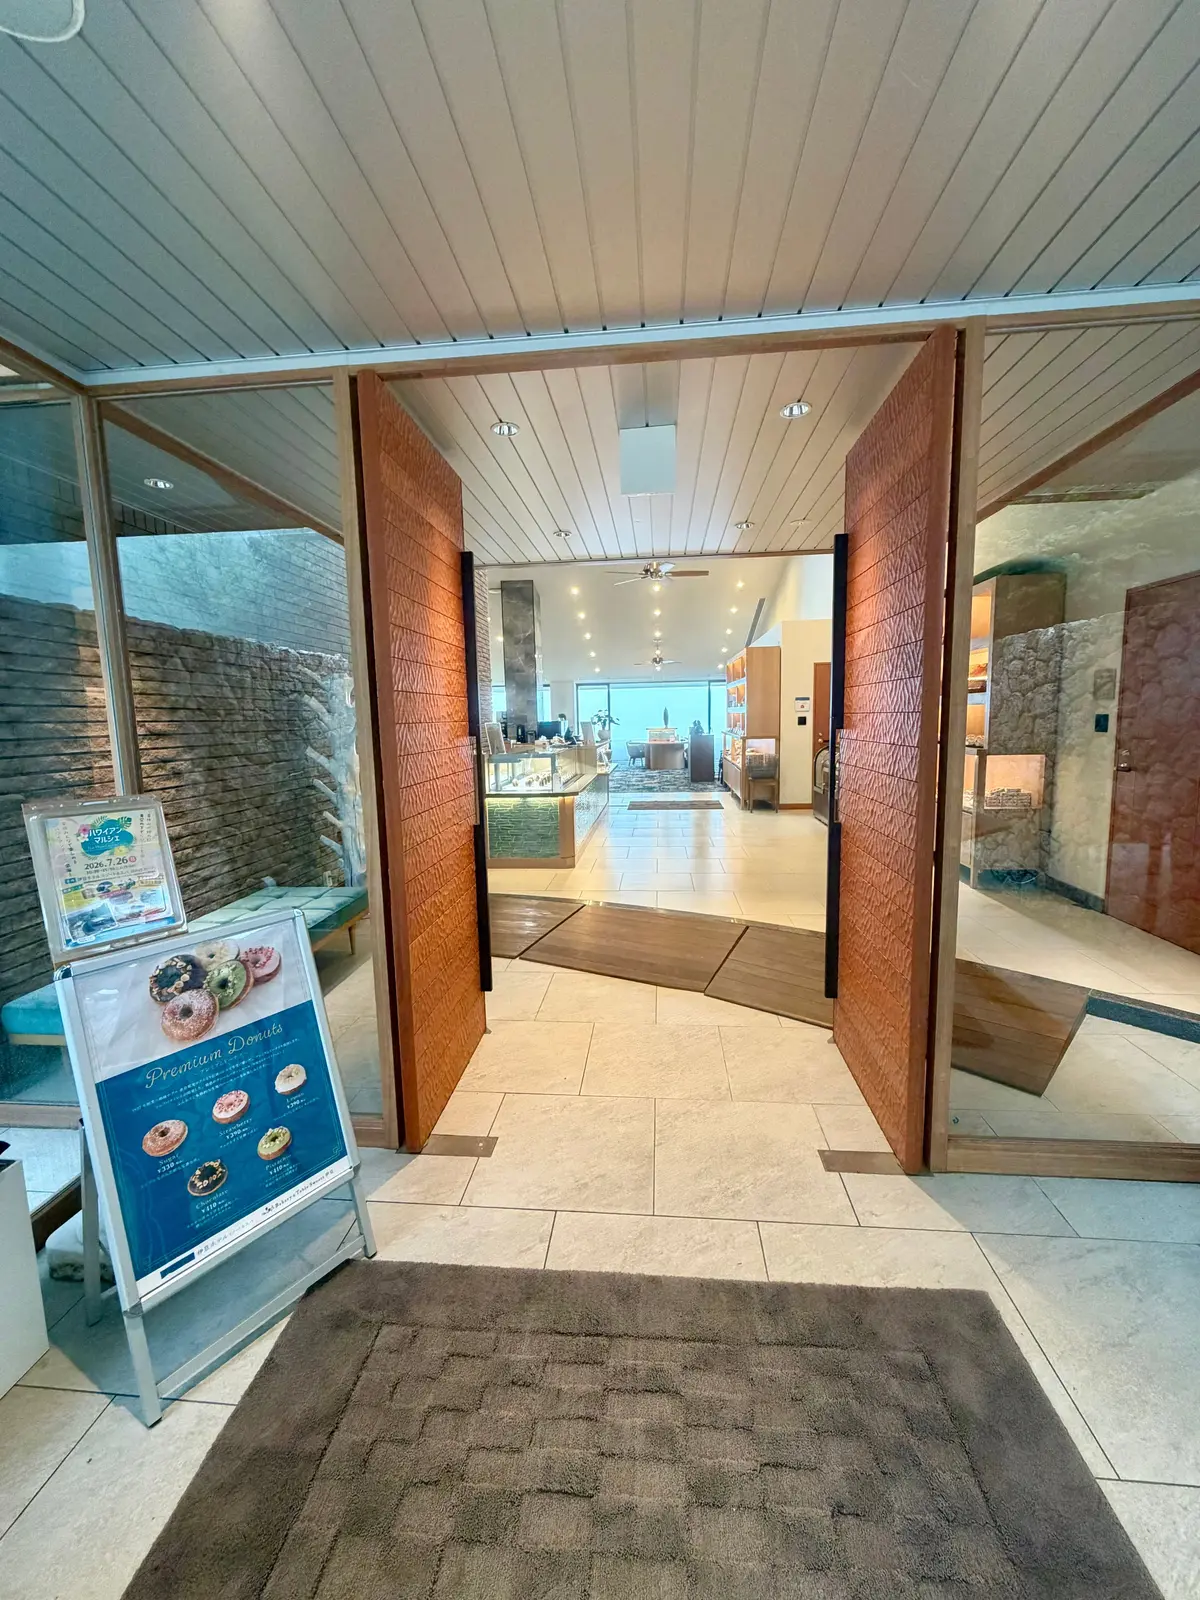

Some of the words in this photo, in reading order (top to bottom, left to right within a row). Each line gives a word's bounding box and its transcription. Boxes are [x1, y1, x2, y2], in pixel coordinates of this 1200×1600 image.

[89, 826, 122, 837] ハワイアン
[94, 835, 120, 844] マルシェ
[84, 856, 128, 870] 2026.7.26
[145, 1049, 222, 1089] Premium
[227, 1022, 283, 1055] Donuts
[218, 1118, 252, 1137] Strawberry
[159, 1153, 180, 1166] Sugar
[157, 1162, 175, 1174] ¥330
[195, 1190, 229, 1210] Chocolate
